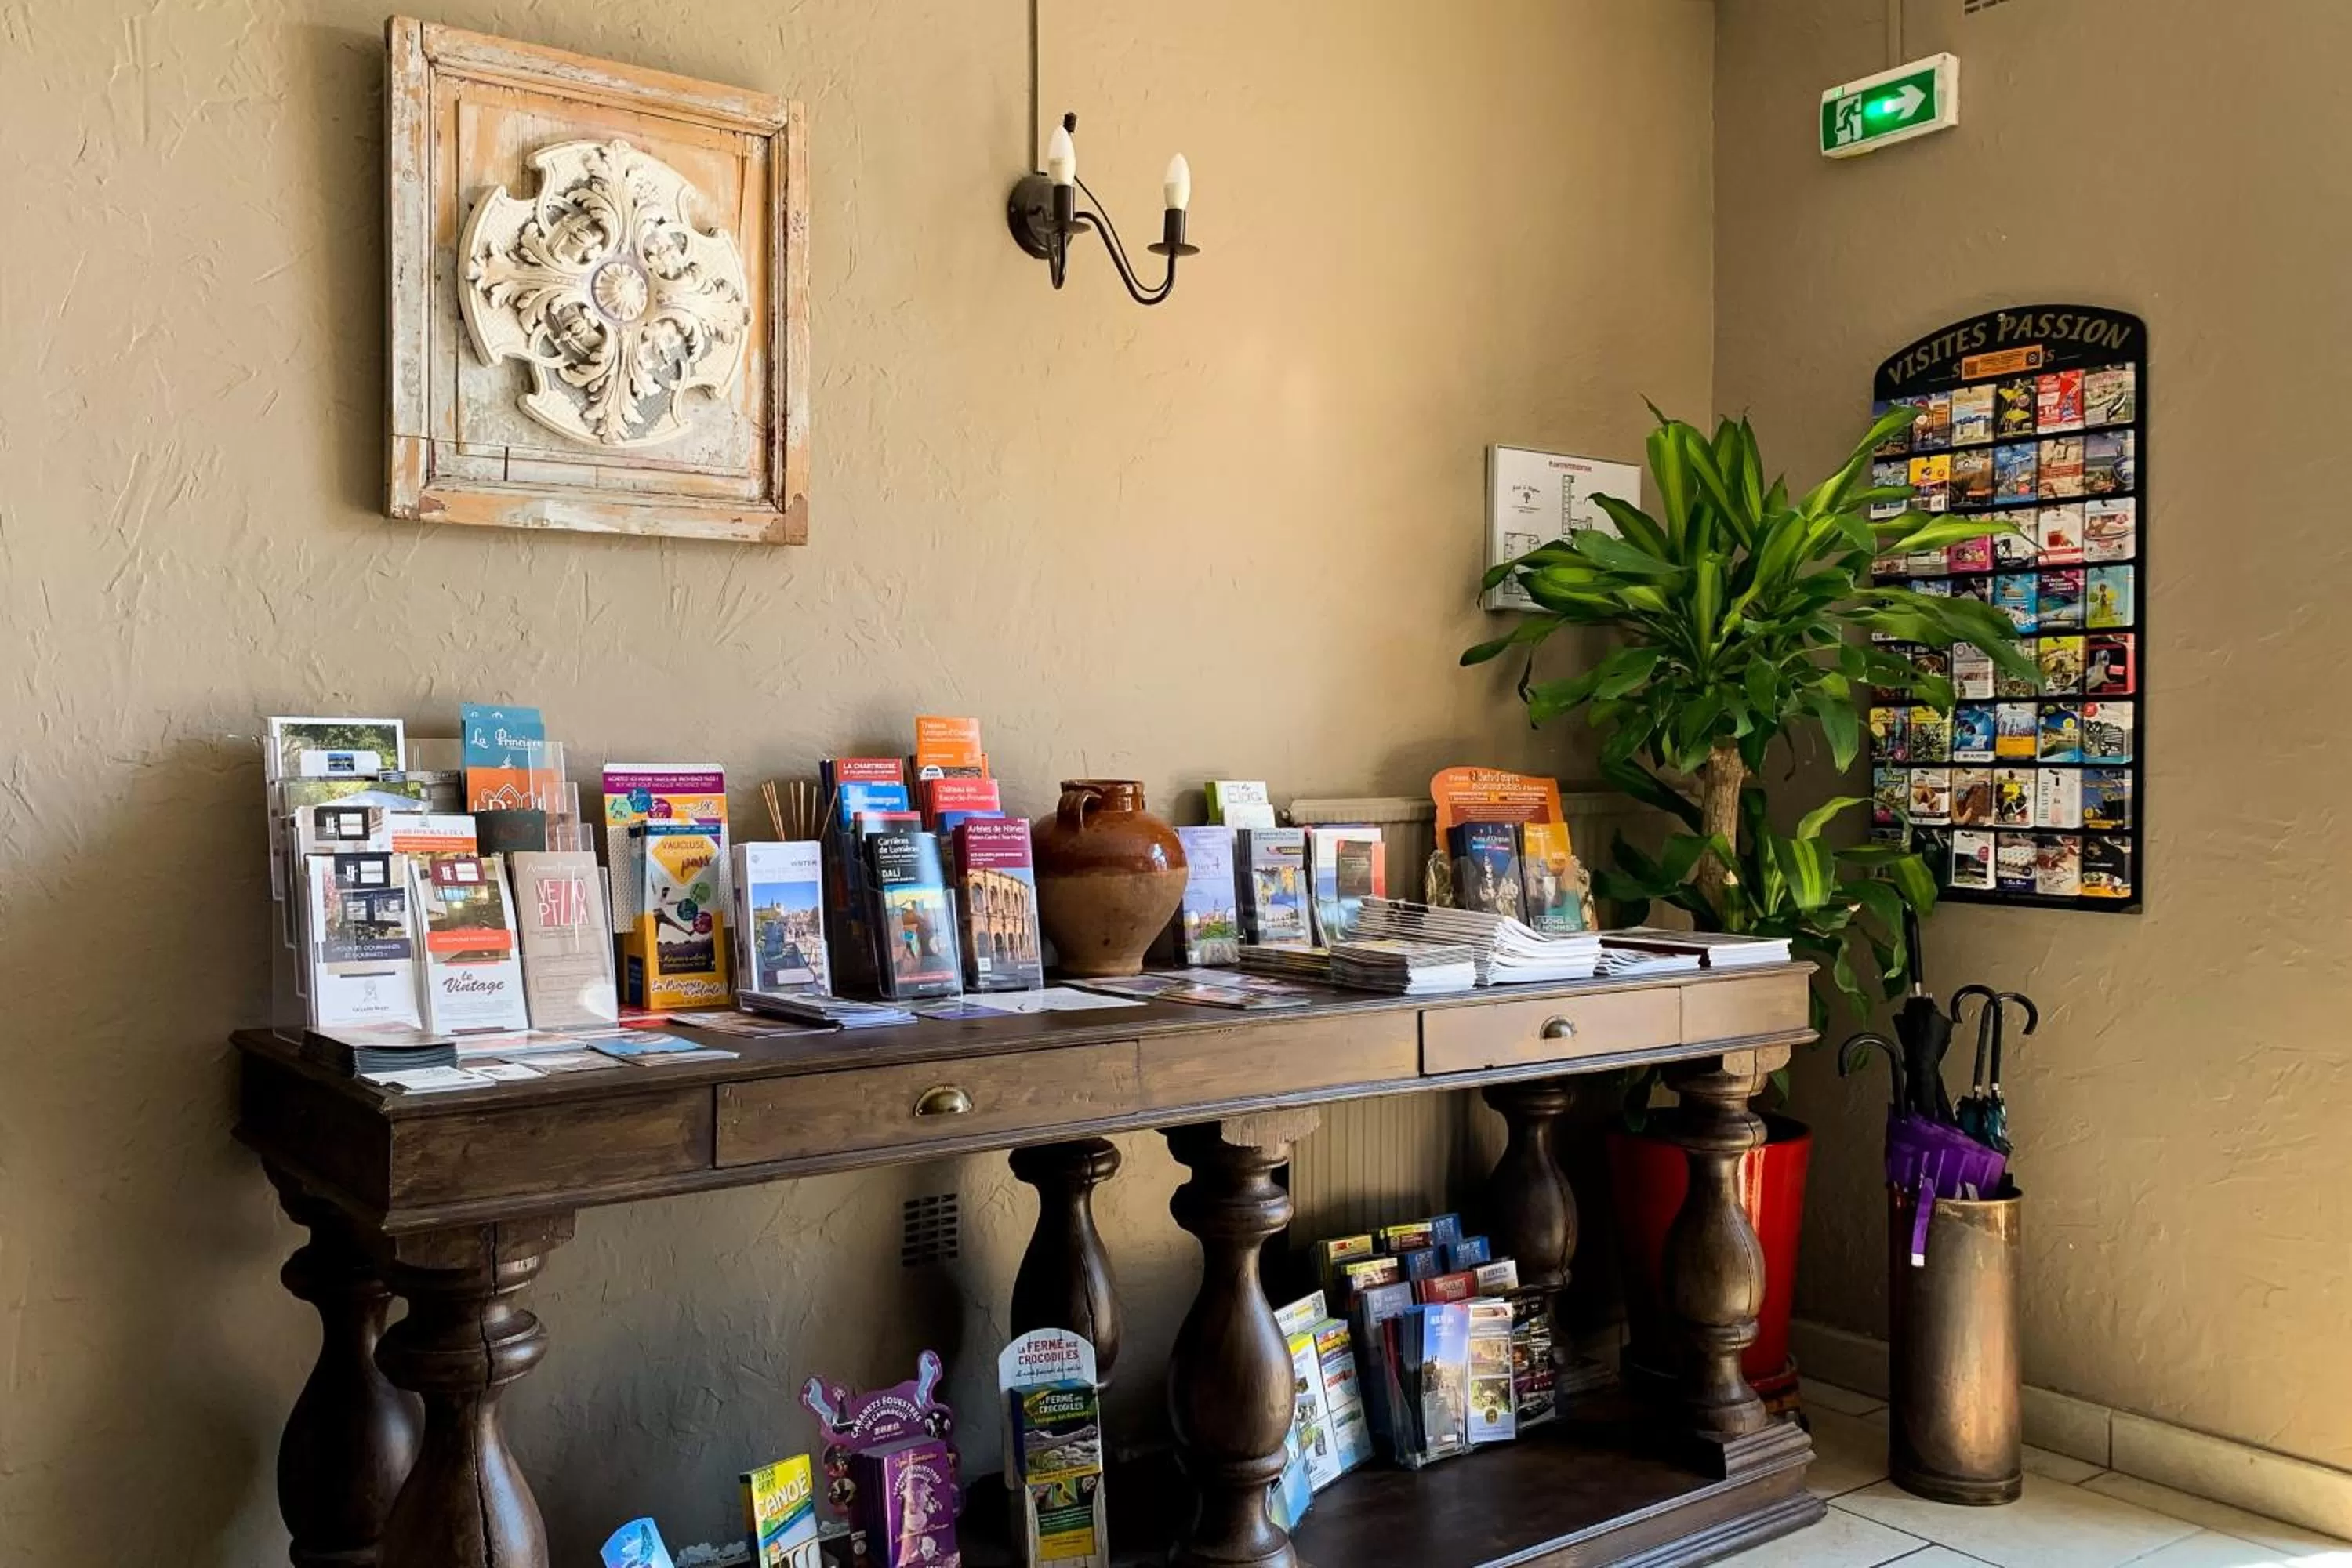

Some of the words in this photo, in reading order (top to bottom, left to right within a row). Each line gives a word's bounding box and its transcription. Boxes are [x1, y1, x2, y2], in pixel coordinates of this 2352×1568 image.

[1888, 322, 1987, 385] VISITES
[1998, 314, 2131, 349] PASSION
[662, 840, 704, 849] VAUCLUSE
[442, 977, 505, 996] Vintage
[1027, 1338, 1064, 1353] FERME
[1018, 1349, 1080, 1365] CROCODILES
[1046, 1393, 1073, 1404] FERME
[1039, 1403, 1084, 1414] CROCODILES
